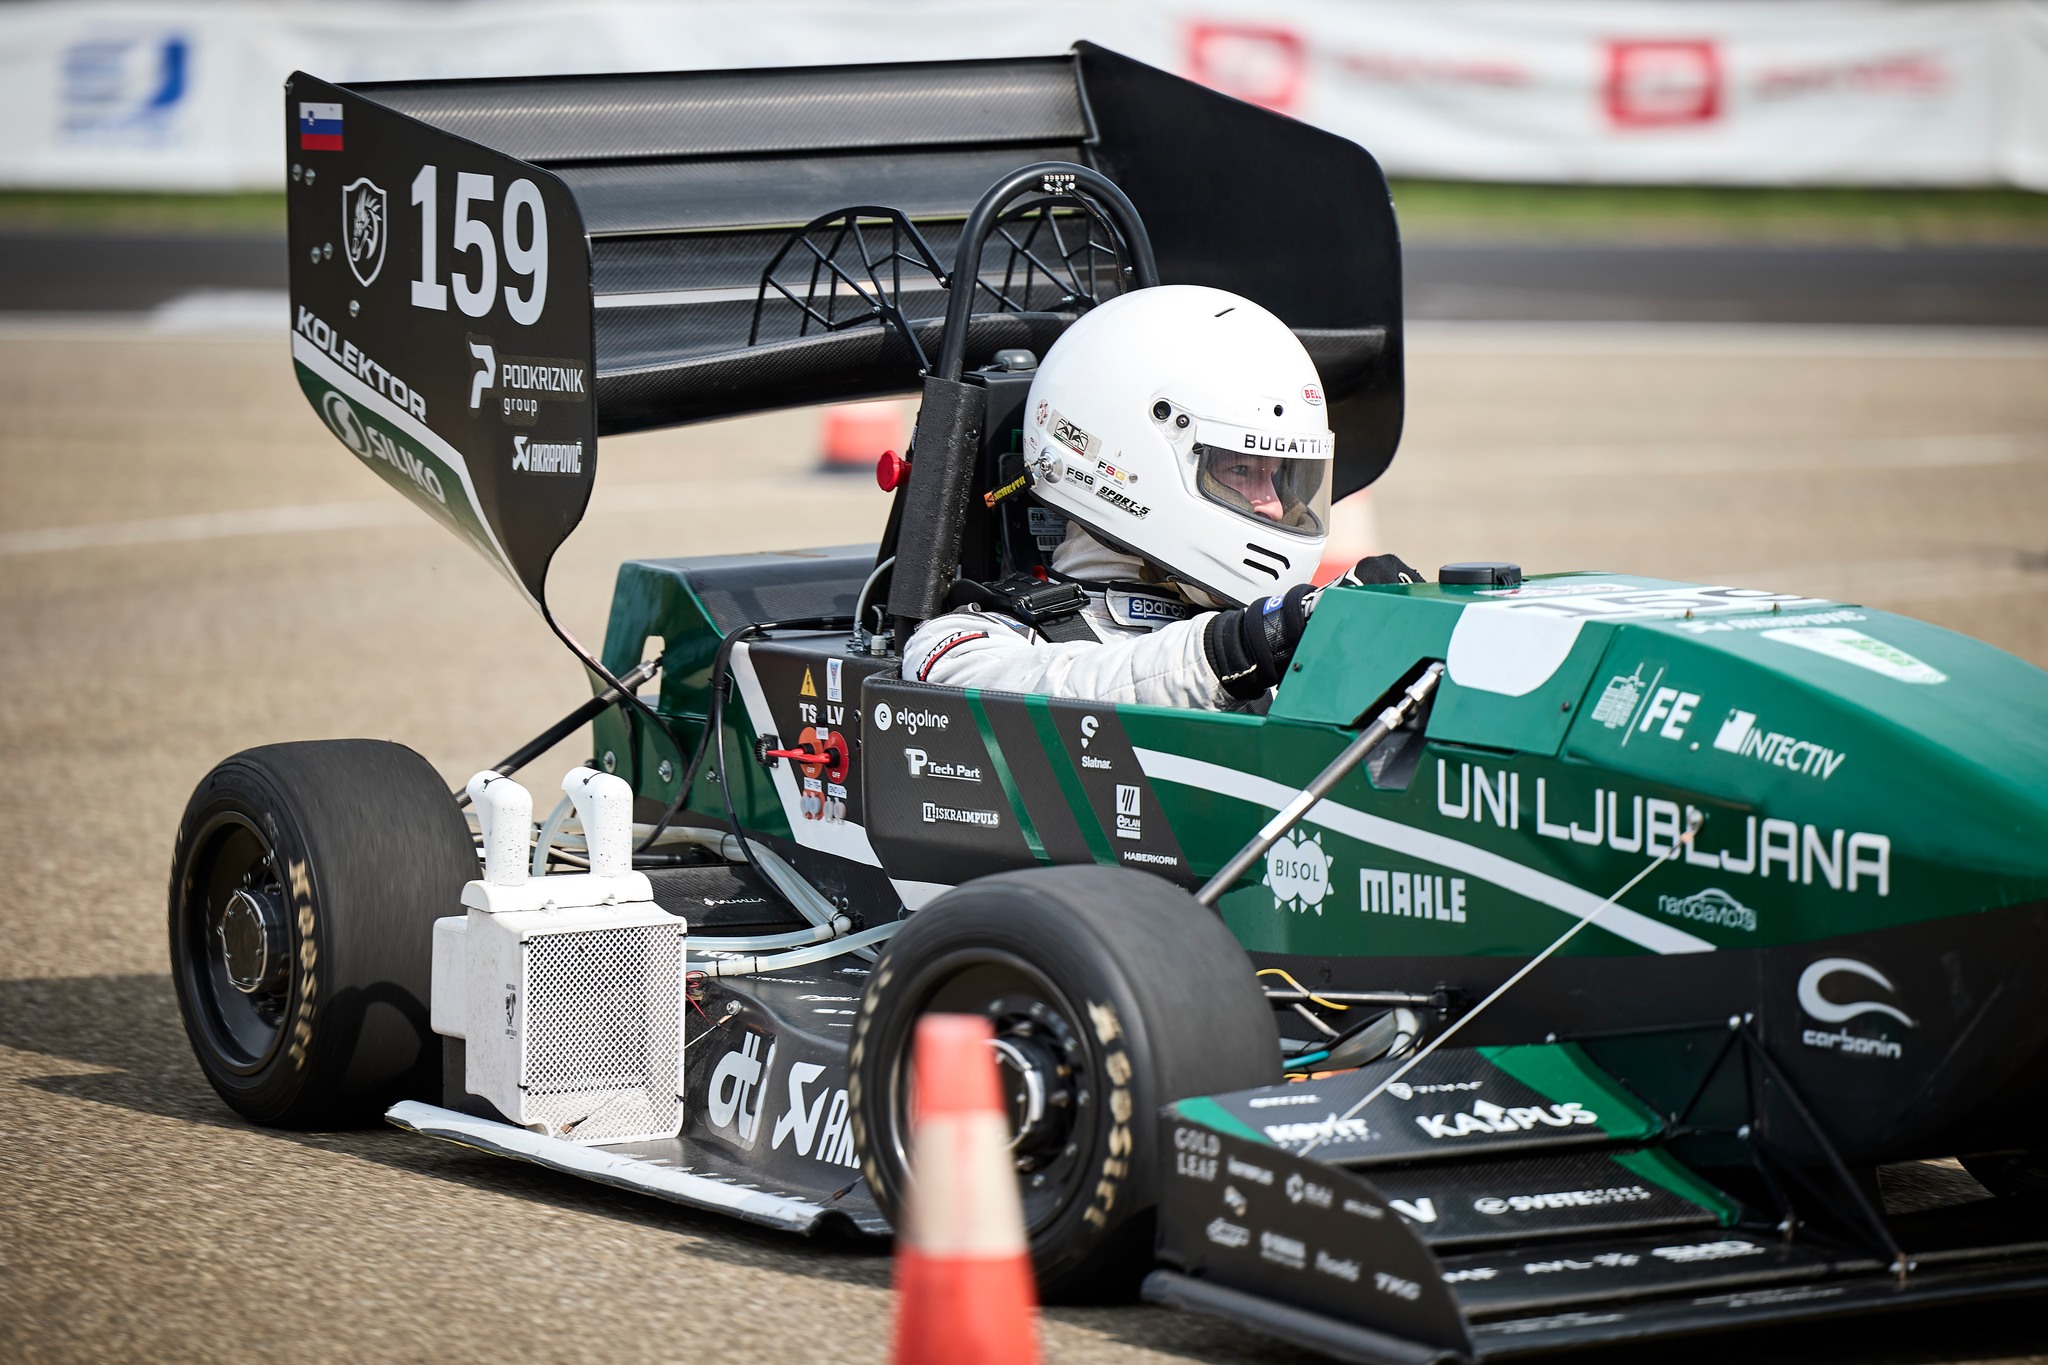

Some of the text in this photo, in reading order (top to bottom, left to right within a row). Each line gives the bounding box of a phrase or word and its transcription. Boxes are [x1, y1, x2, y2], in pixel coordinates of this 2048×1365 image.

[411, 164, 549, 325] 159
[297, 305, 428, 423] KOLEKTOR
[503, 364, 584, 393] PODKRIZNIK
[1304, 389, 1322, 400] BELL
[503, 397, 538, 417] group
[1244, 433, 1321, 454] BUGATTI
[1066, 466, 1094, 486] FSG
[1097, 461, 1126, 481] FSG
[1131, 599, 1188, 618] sparco
[799, 702, 845, 726] TS LV
[896, 707, 950, 736] elgoline
[1638, 686, 1701, 741] FE
[928, 762, 955, 776] Tech
[957, 765, 981, 779] Part
[1436, 757, 1891, 897] UNI LJUBLJANA
[1124, 851, 1178, 866] HABERKORN
[1275, 859, 1320, 882] BISOL
[1360, 868, 1467, 923] MAHLE
